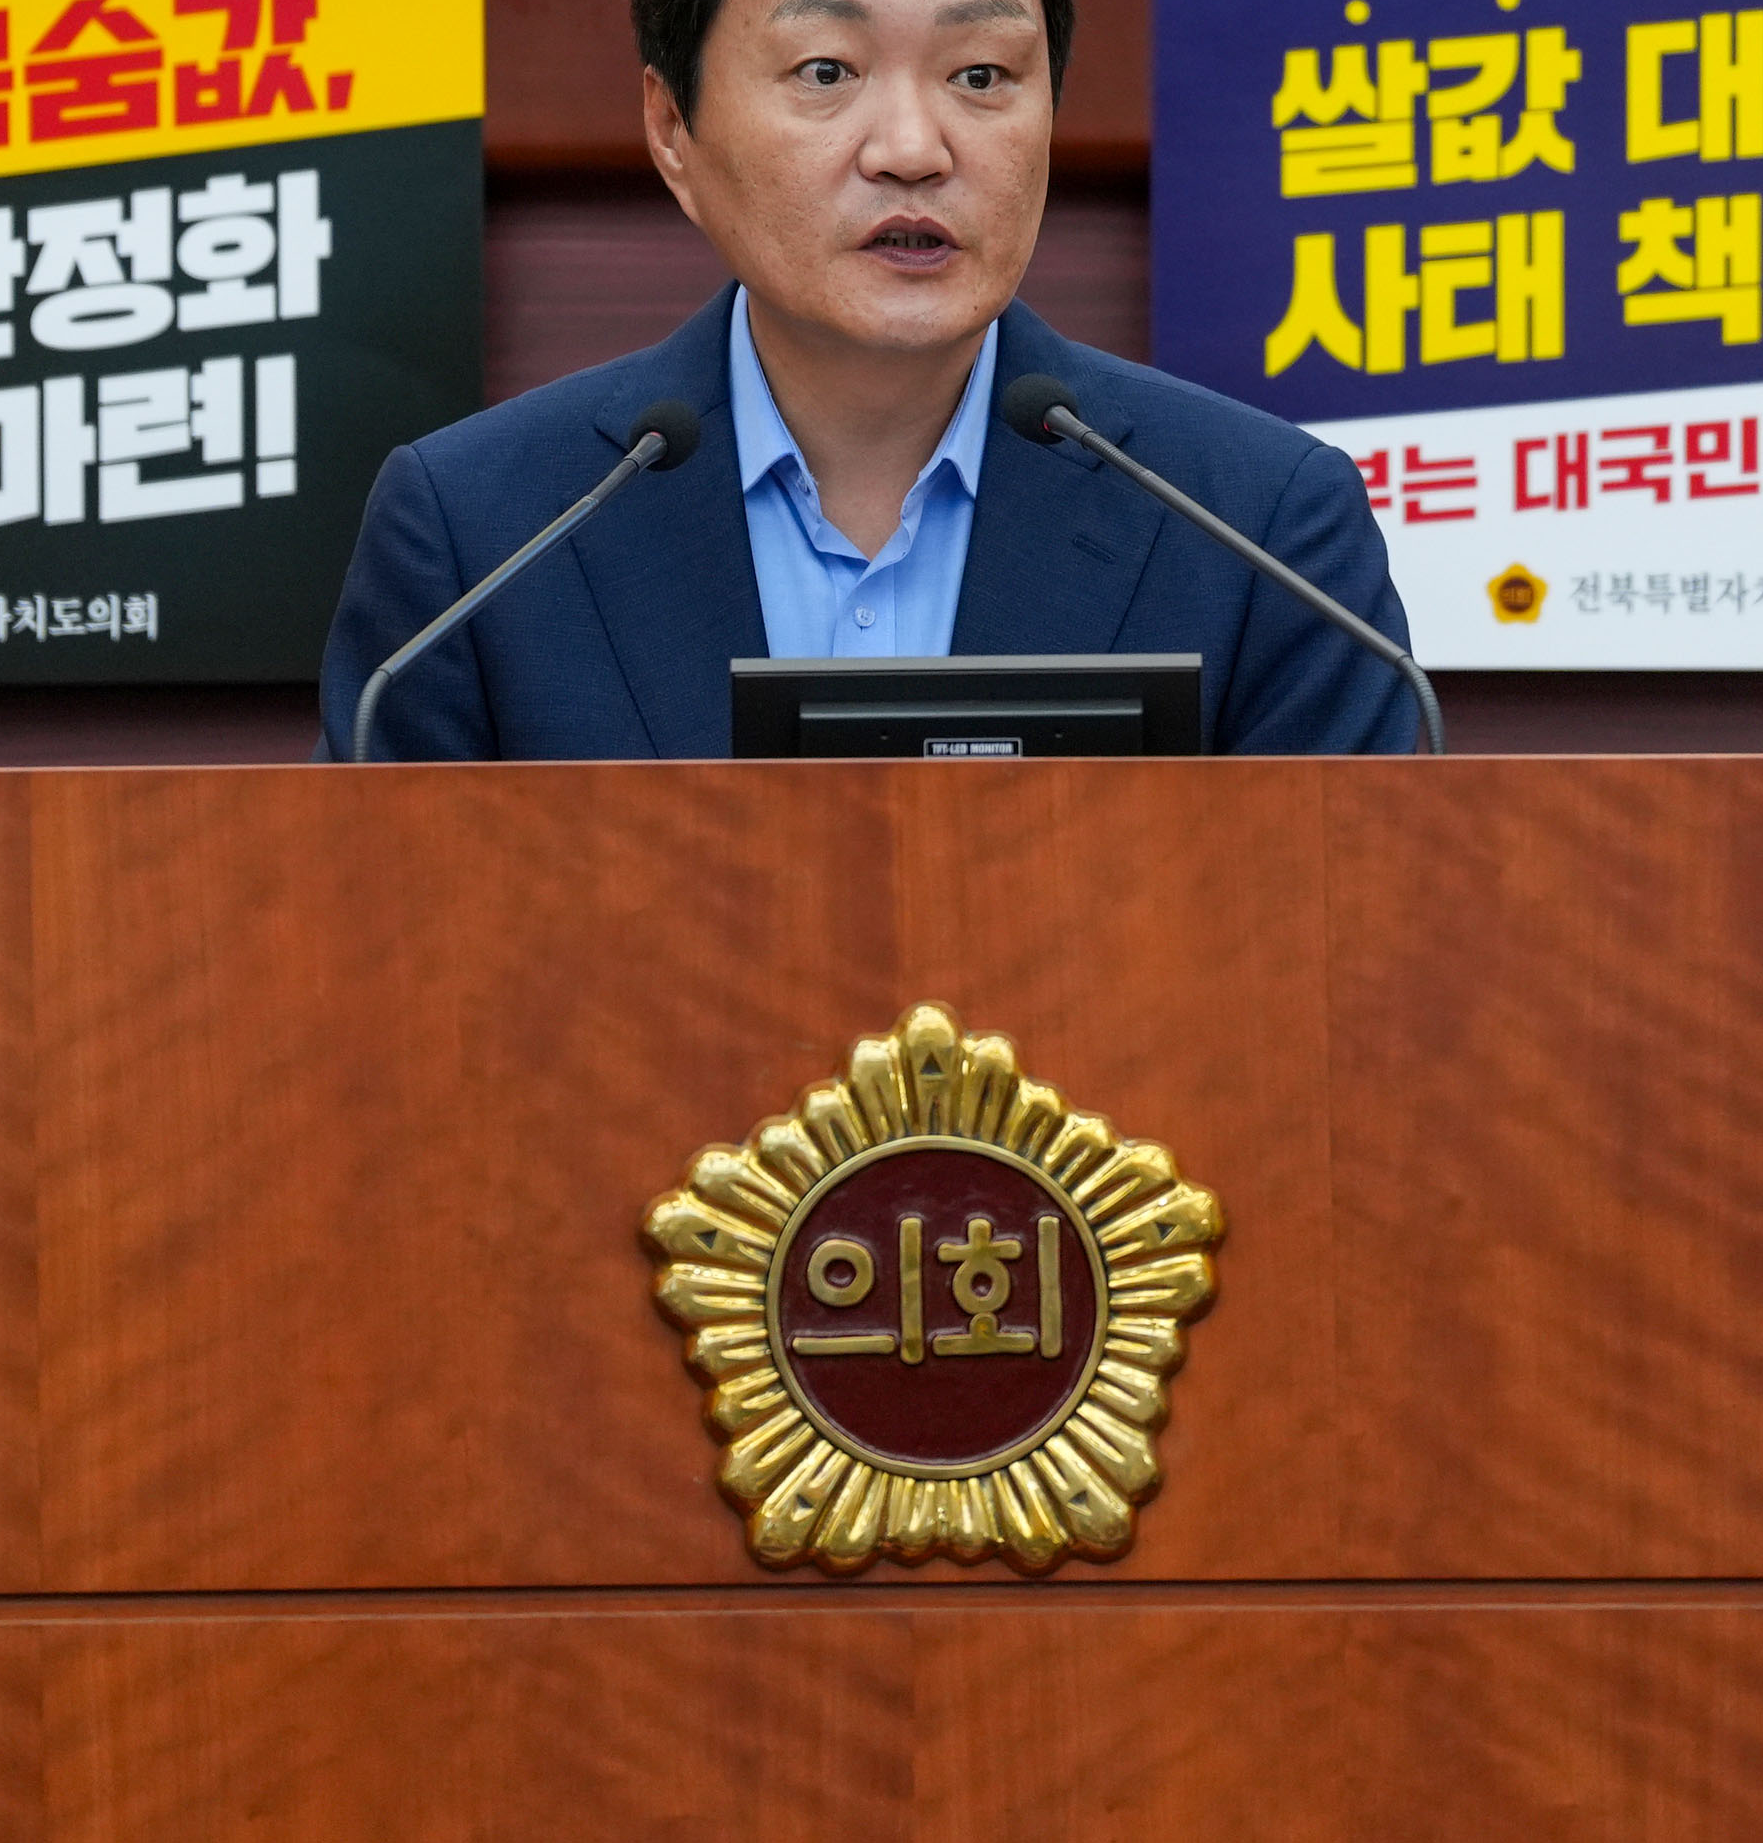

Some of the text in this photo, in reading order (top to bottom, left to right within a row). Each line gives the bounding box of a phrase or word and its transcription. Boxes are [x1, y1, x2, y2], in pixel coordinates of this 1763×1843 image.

[1273, 28, 1580, 196] 쌀값
[1266, 211, 1563, 374] 사태
[1516, 419, 1758, 510] 대국민
[969, 743, 1014, 755] MONITOR
[791, 1216, 1063, 1365] 의회
